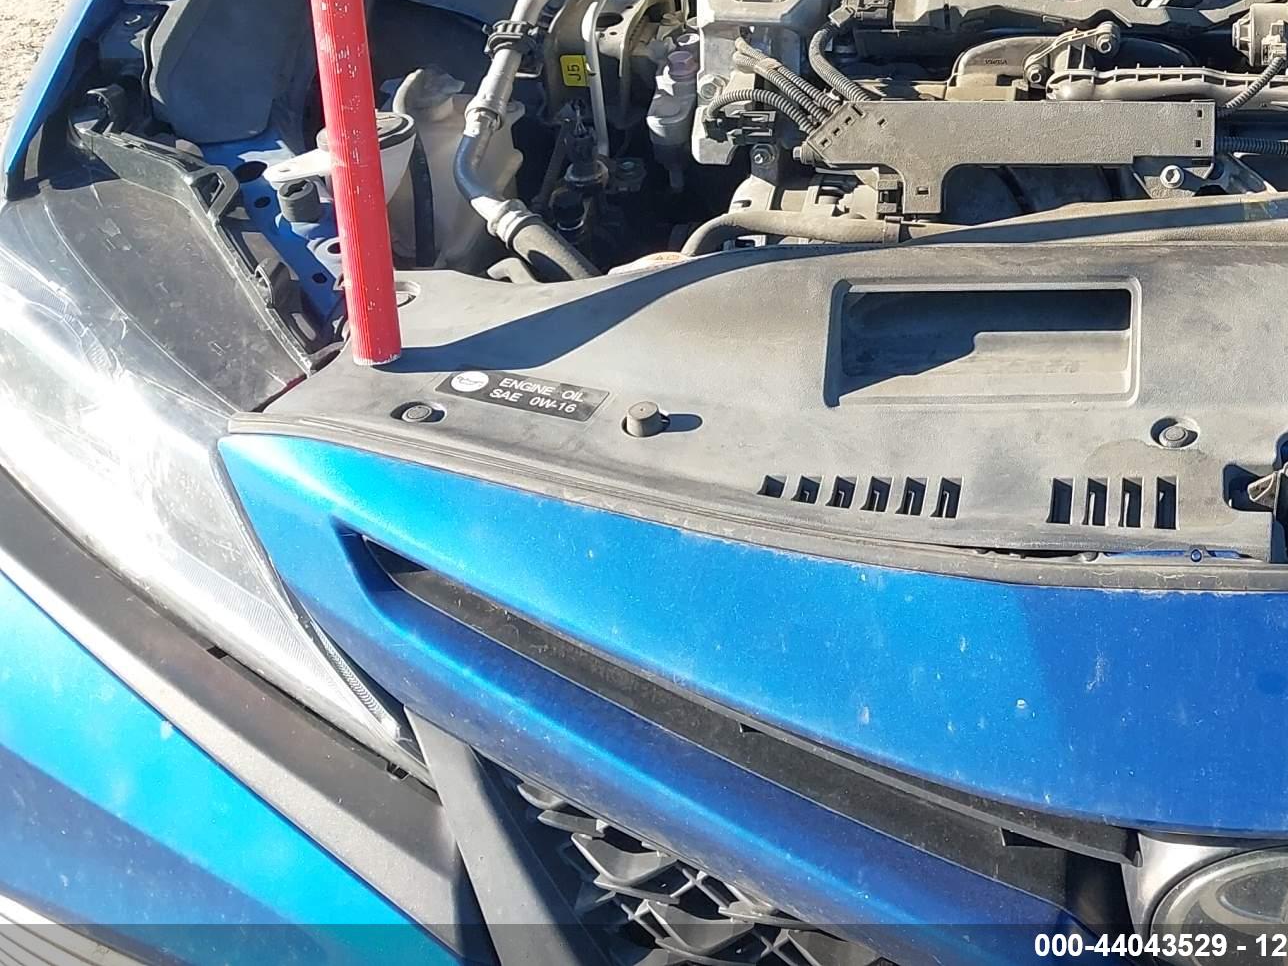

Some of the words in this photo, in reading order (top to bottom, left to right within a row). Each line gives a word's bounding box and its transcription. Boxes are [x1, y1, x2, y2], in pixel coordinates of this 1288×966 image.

[567, 64, 582, 81] J5
[489, 388, 523, 402] SAE
[529, 396, 577, 414] 0W-16
[499, 377, 555, 397] ENGINE
[561, 389, 585, 403] OIL
